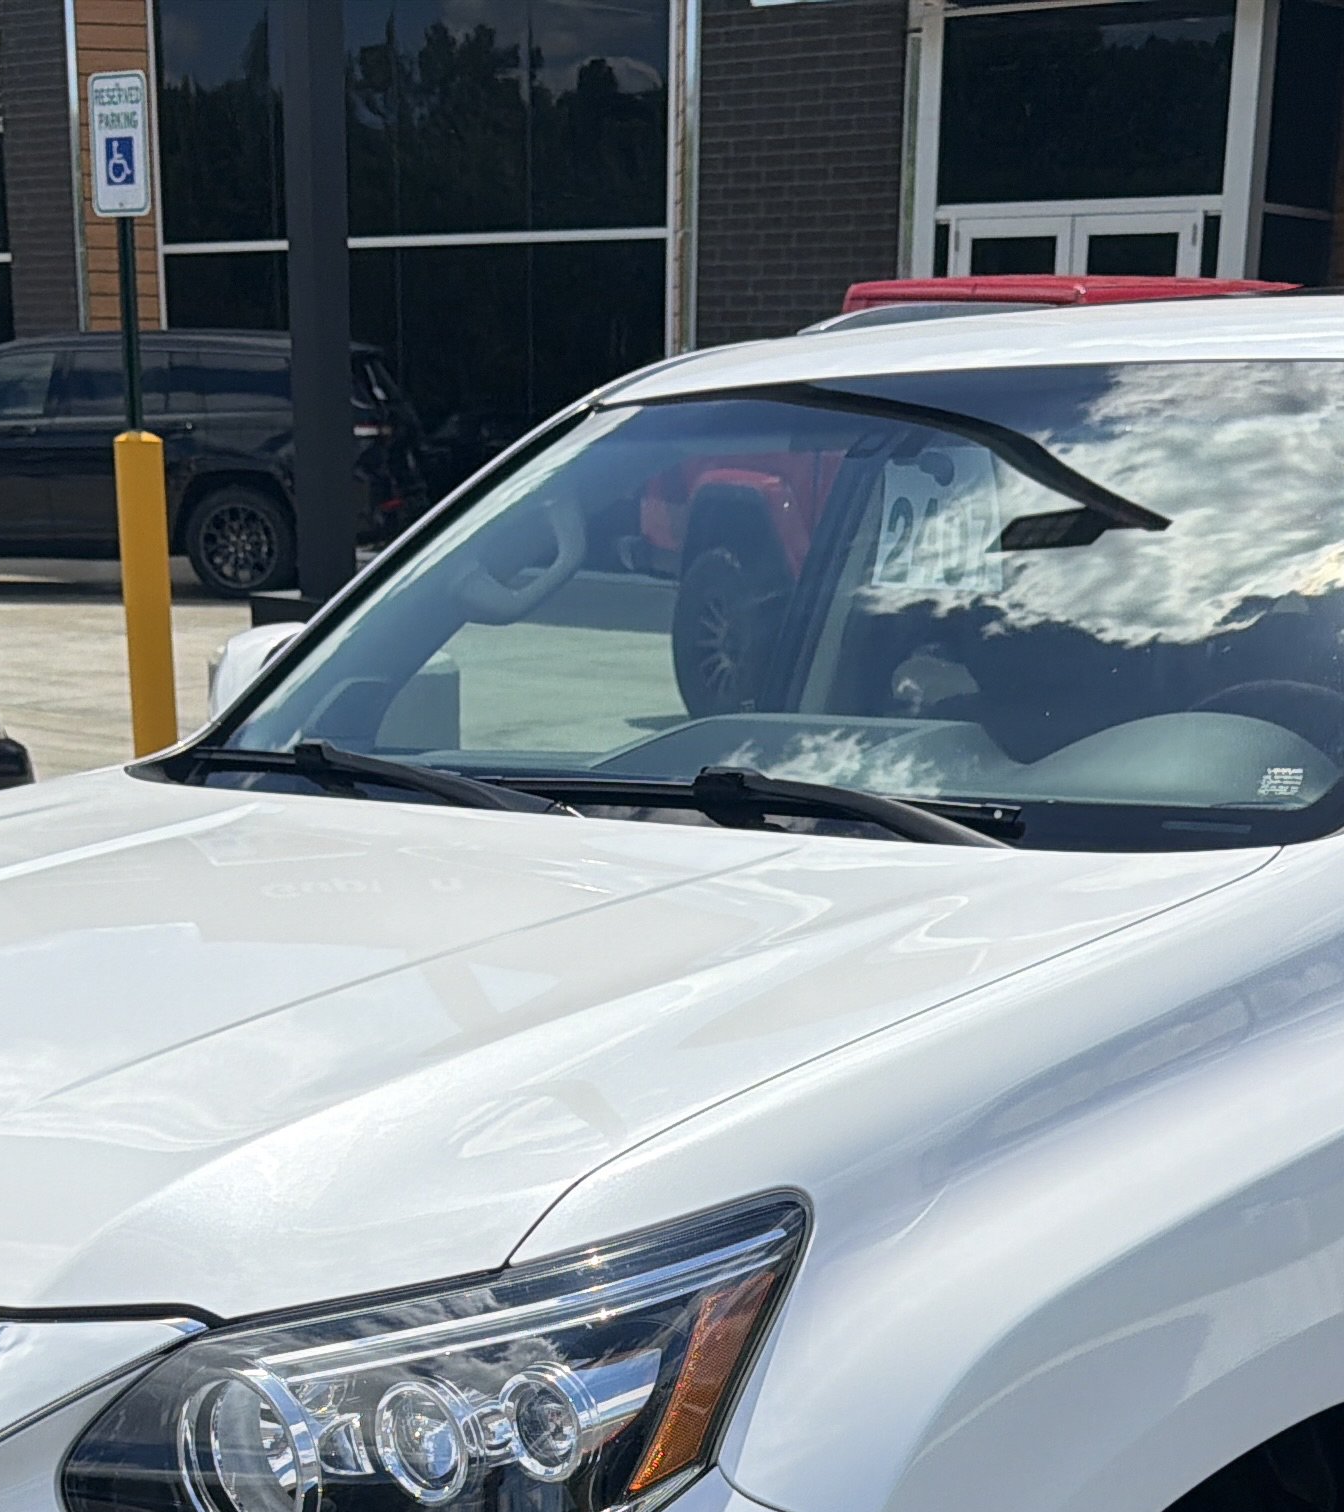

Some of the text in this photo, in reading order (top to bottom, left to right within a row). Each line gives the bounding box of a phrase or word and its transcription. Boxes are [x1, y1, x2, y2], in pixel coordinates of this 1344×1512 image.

[94, 86, 141, 106] RESERVED
[98, 111, 138, 130] PARKING
[878, 496, 994, 587] 2407
